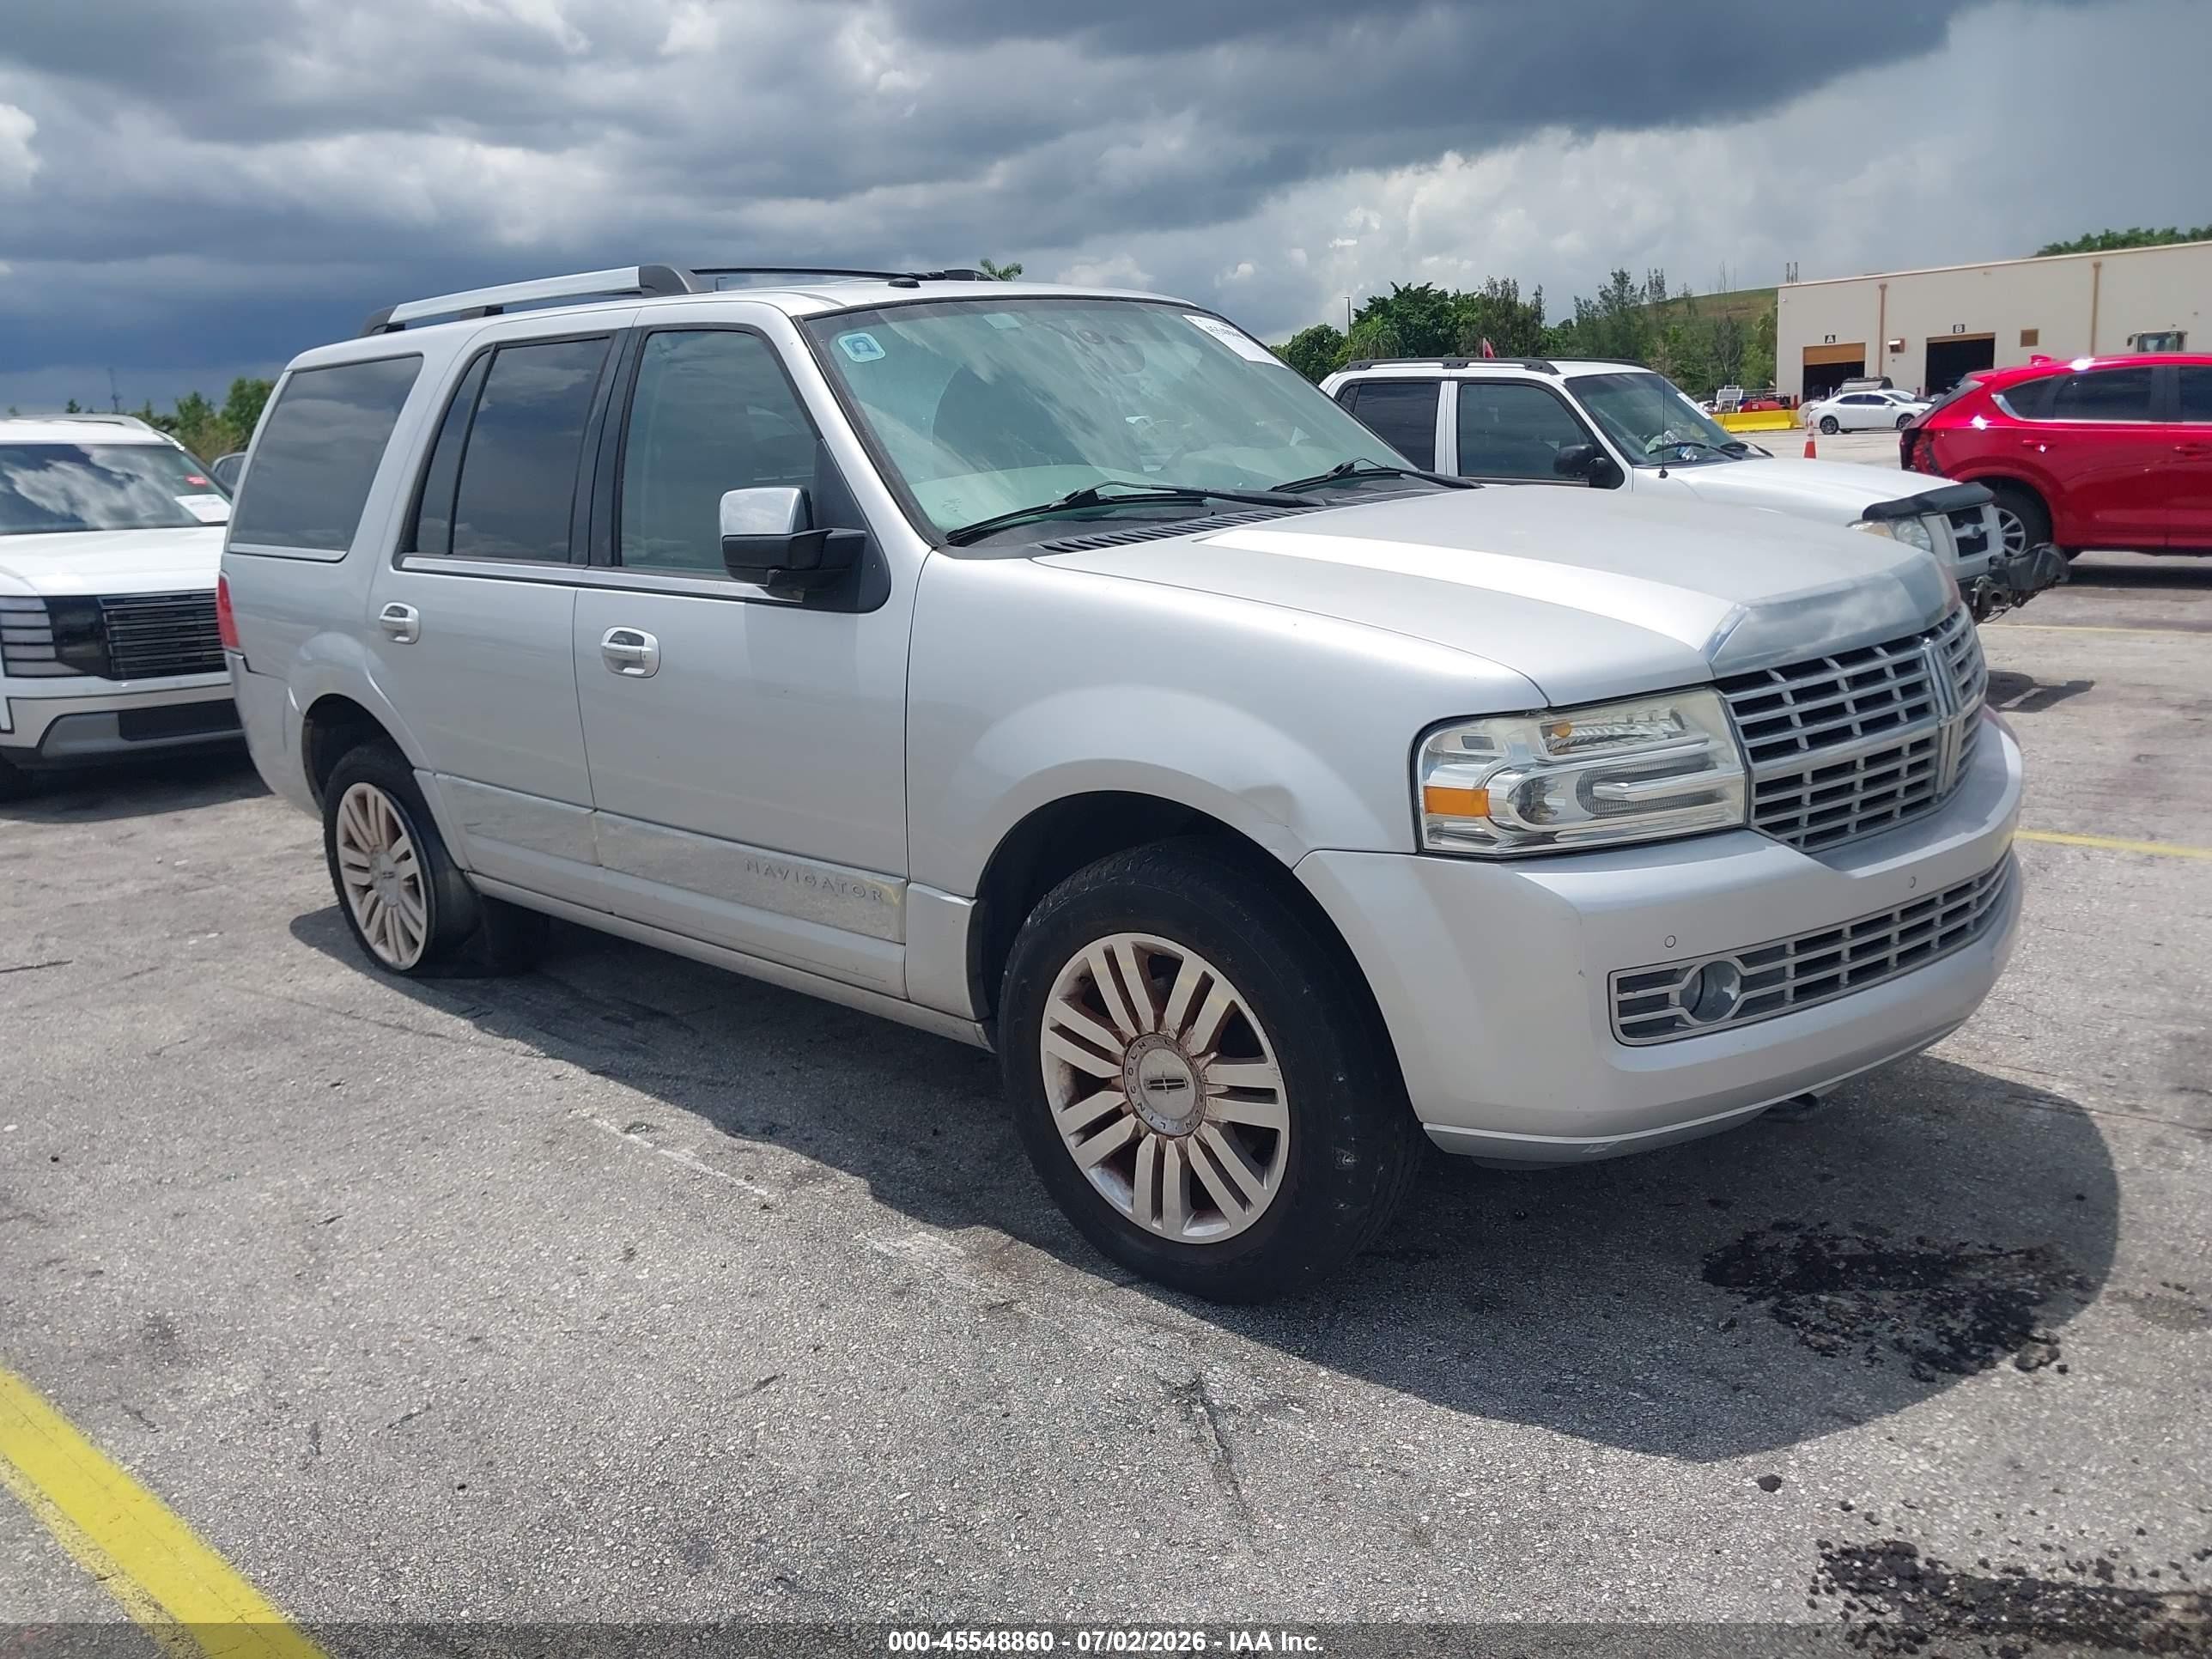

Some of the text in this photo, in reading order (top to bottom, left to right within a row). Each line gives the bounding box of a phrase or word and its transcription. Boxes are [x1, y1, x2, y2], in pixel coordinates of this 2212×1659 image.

[1826, 335, 1834, 343] A
[1955, 325, 1963, 333] B
[744, 858, 884, 902] NAVIGATOR
[1127, 1042, 1167, 1130] LINCOLN
